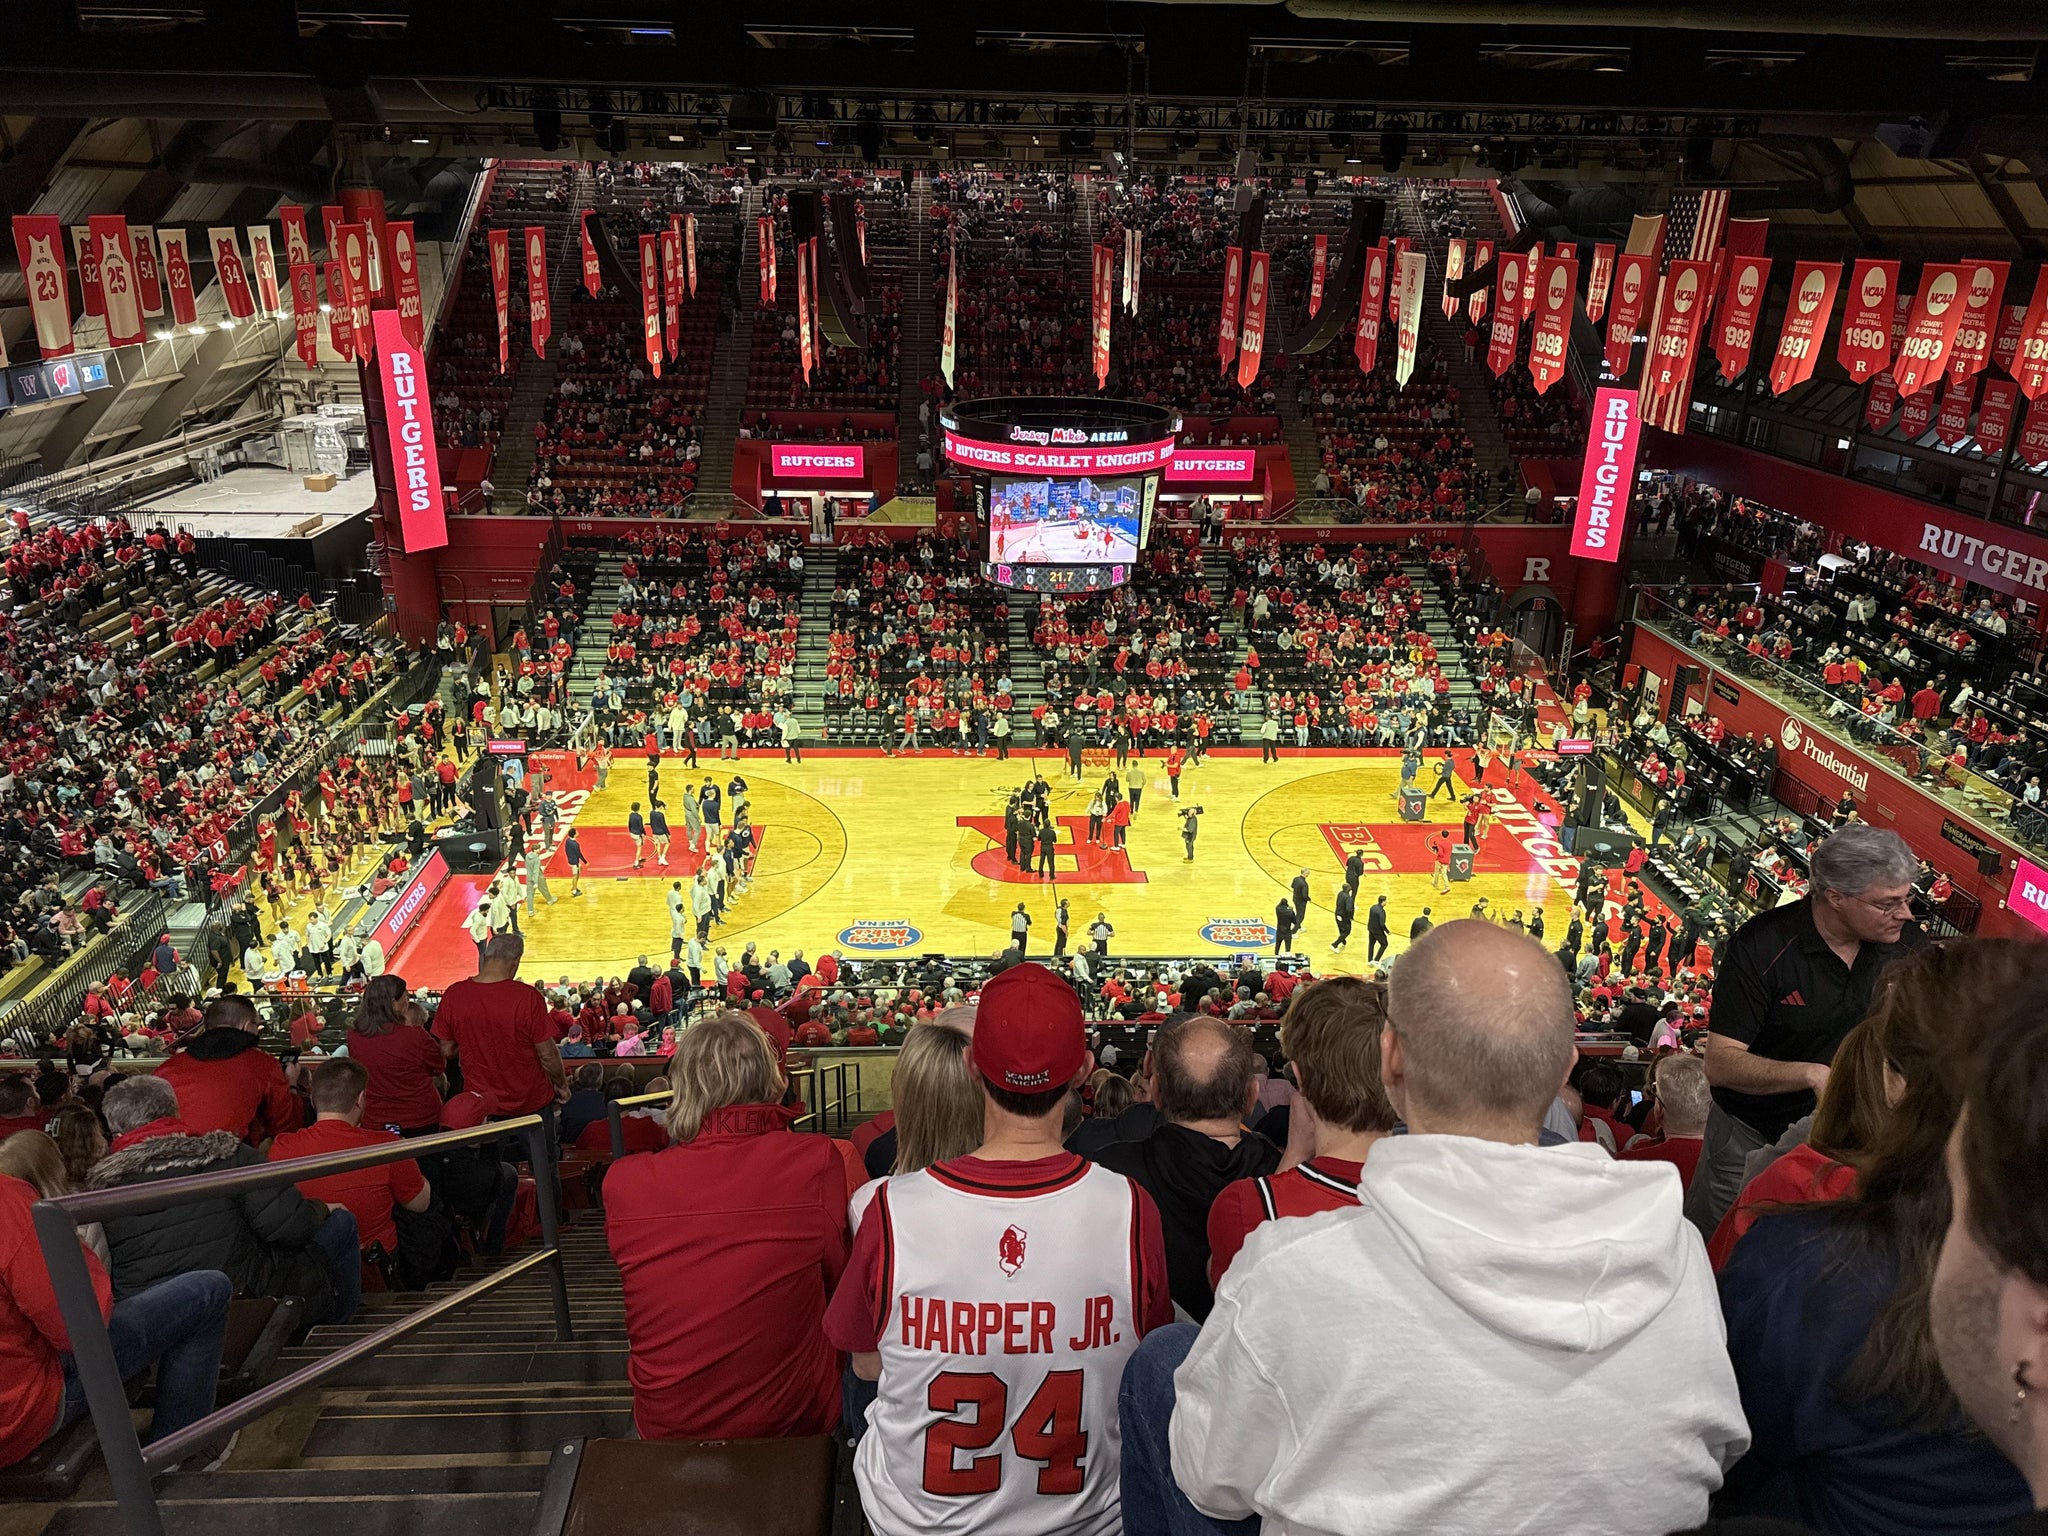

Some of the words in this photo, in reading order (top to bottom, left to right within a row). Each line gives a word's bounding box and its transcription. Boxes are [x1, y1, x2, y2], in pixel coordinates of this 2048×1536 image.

[84, 263, 99, 283] 32
[140, 261, 154, 279] 54
[224, 263, 242, 285] 34
[260, 260, 272, 280] 30
[36, 270, 59, 301] 23
[107, 266, 127, 294] 25
[171, 267, 187, 289] 32
[1550, 288, 1566, 299] NCAA
[1624, 281, 1640, 293] NCAA
[1738, 284, 1756, 296] NCAA
[1863, 286, 1885, 298] NCAA
[1674, 289, 1695, 301] NCAA
[1800, 290, 1822, 304] NCAA
[1929, 292, 1954, 304] NCAA
[1859, 311, 1881, 320] WOMEN'S
[1920, 319, 1944, 329] WOMEN'S
[1611, 323, 1635, 345] 1994
[1725, 325, 1751, 349] 1992
[1845, 327, 1885, 351] 1990
[1954, 328, 1988, 350] 988
[1535, 331, 1563, 357] 1998
[1657, 334, 1689, 360] 1993
[1778, 335, 1811, 360] 1991
[1901, 336, 1944, 361] 1989
[1998, 337, 2018, 350] 198
[1729, 360, 1736, 373] R
[1856, 360, 1868, 372] R
[1955, 360, 1966, 373] R
[1539, 368, 1548, 381] R
[1660, 370, 1672, 384] R
[1778, 371, 1787, 384] R
[1904, 371, 1917, 385] R
[2031, 374, 2043, 387] R
[1870, 399, 1891, 414] 1943
[2034, 400, 2048, 411] EC
[1903, 406, 1927, 421] 1949
[1940, 412, 1965, 430] 1950
[390, 352, 431, 512] RUTGERS
[1010, 426, 1050, 446] Jersey
[1050, 428, 1089, 445] Mike's
[1090, 431, 1128, 442] ARENA
[1909, 425, 1914, 433] R
[1981, 421, 2004, 437] 1951
[780, 455, 856, 468] RUTGERS
[956, 445, 1011, 465] RUTGERS
[1014, 452, 1092, 468] SCARLET
[1095, 449, 1155, 468] KNIGHTS
[1173, 460, 1247, 471] RUTGERS
[1585, 398, 1630, 548] RUTGERS
[576, 522, 593, 531] 106
[1316, 529, 1331, 538] 102
[1431, 529, 1448, 537] 101
[1714, 552, 1752, 575] RUTGERS
[1919, 523, 2048, 592] RUTGER
[997, 563, 1013, 586] R
[1026, 567, 1036, 575] RU
[1049, 571, 1074, 582] 21.7
[1086, 567, 1099, 575] PSU
[1111, 564, 1124, 586] R
[1522, 557, 1551, 581] R
[1026, 574, 1034, 585] 0
[1089, 574, 1097, 585] 0
[1532, 598, 1546, 610] R
[1802, 735, 1869, 792] Prudential
[269, 803, 284, 823] Prud
[214, 840, 227, 860] R
[957, 816, 1149, 883] R
[1745, 874, 1759, 900] R
[2021, 880, 2048, 912] RU
[388, 881, 426, 934] RUTGERS
[1005, 1069, 1050, 1081] SCARLET
[1005, 1077, 1050, 1087] KNIGHTS
[901, 1296, 1055, 1355] HARPER
[1069, 1296, 1121, 1353] JR.
[921, 1370, 1089, 1497] 24
